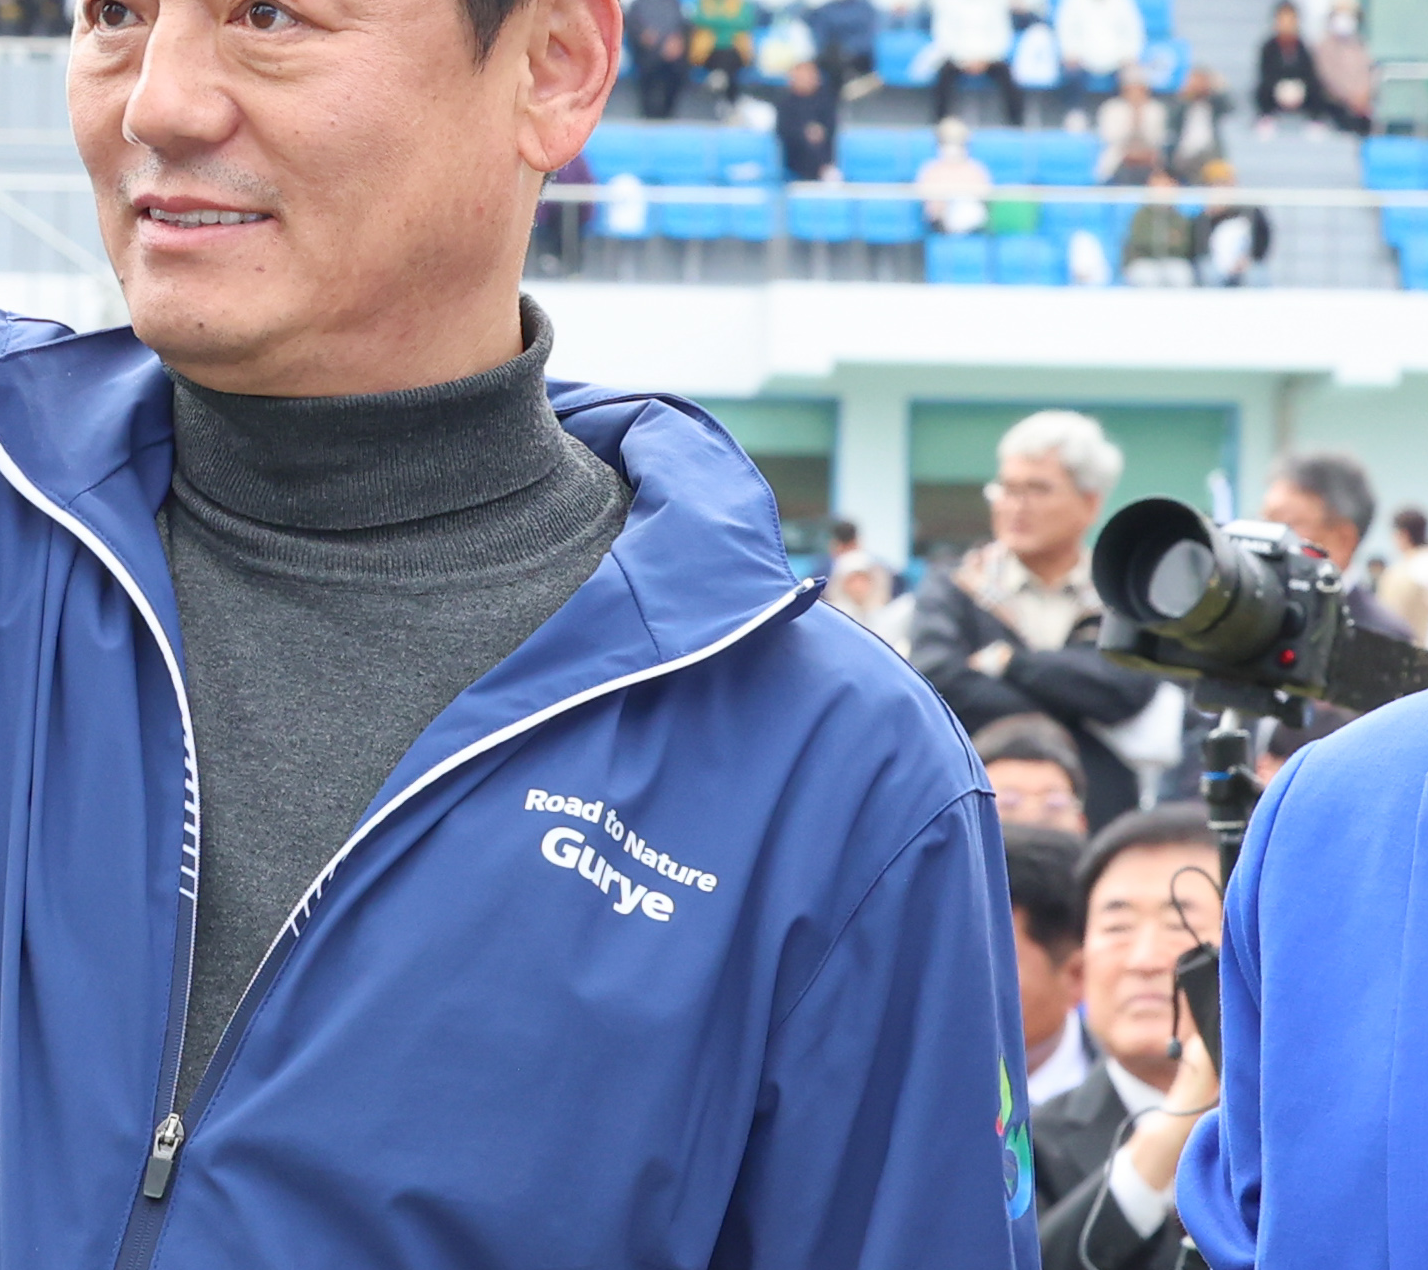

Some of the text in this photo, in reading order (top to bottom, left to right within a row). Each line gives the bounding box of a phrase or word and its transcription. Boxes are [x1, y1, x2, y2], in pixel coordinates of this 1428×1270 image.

[524, 788, 719, 893] Road to Nature
[540, 825, 676, 922] Gurye
